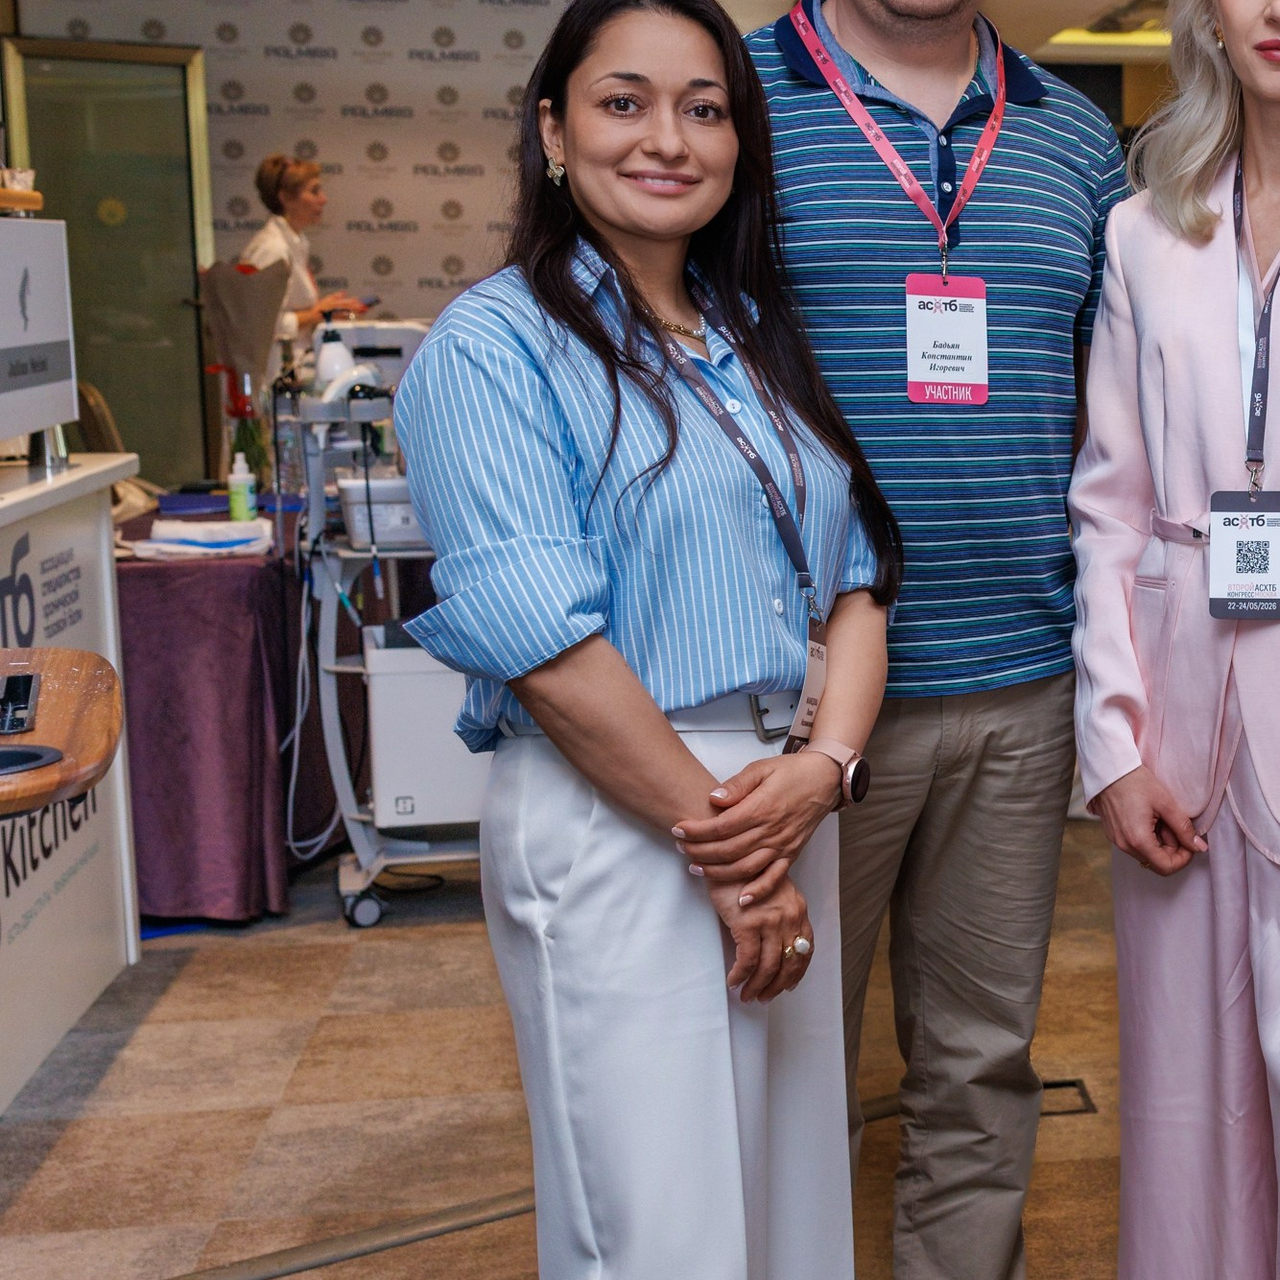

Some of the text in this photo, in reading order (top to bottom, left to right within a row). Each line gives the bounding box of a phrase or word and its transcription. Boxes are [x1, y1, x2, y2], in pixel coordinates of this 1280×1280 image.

[921, 351, 972, 362] Константин
[929, 363, 965, 373] Игоревич
[925, 384, 972, 401] УЧАСТНИК
[1228, 583, 1277, 592] ВТОРОЙ АСХТБ
[1228, 601, 1277, 611] 22-24/05/2026
